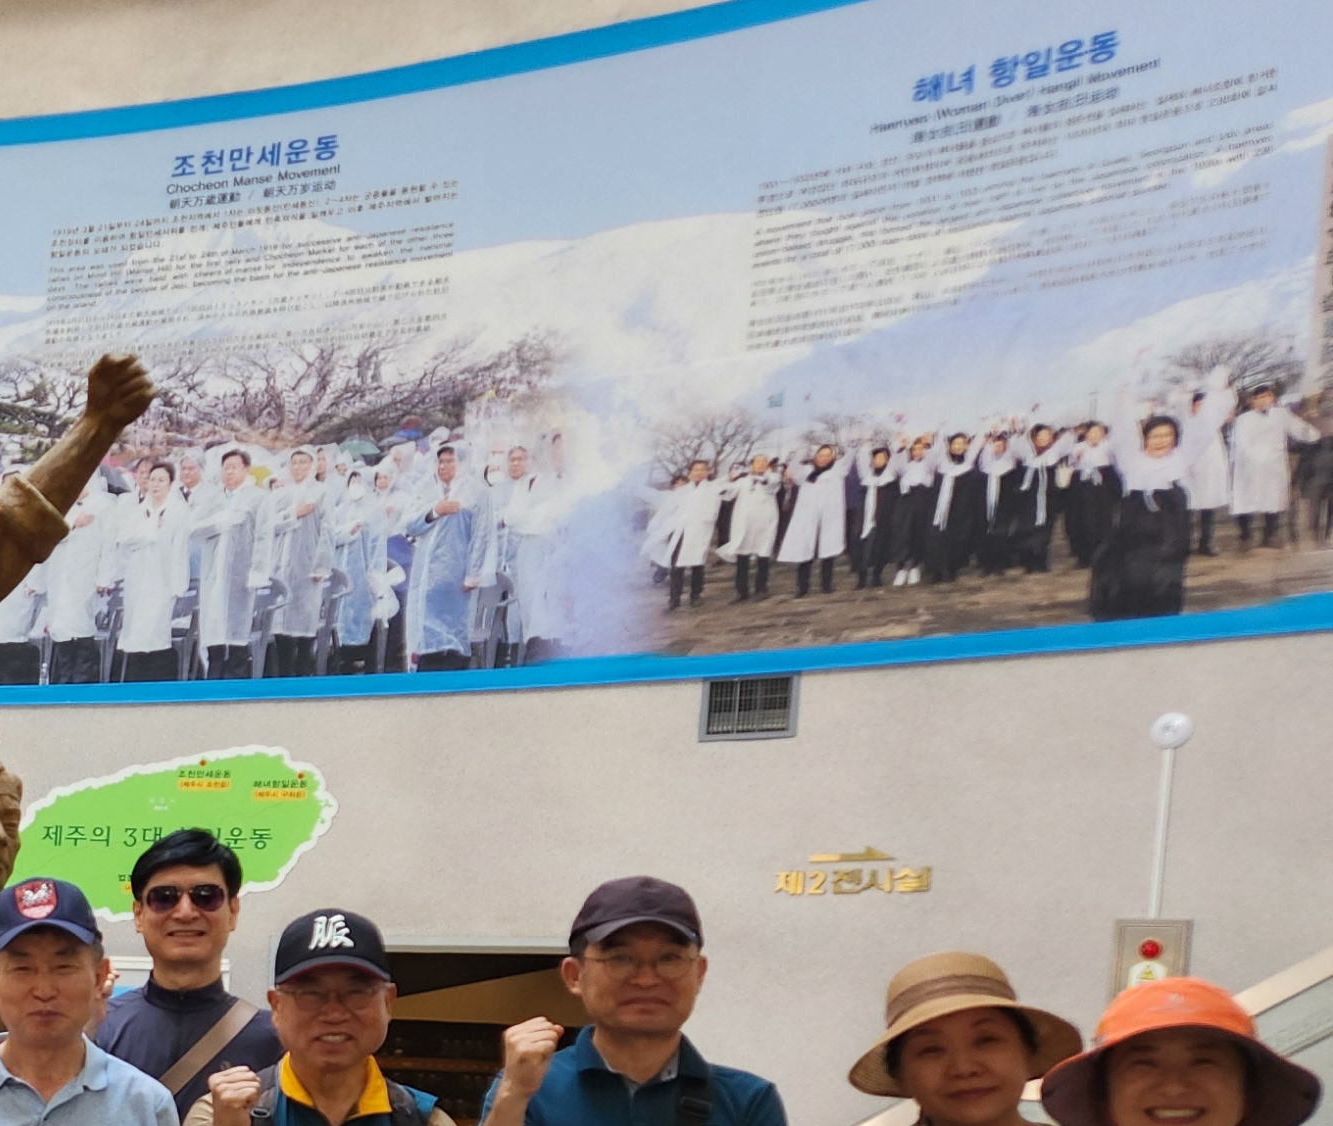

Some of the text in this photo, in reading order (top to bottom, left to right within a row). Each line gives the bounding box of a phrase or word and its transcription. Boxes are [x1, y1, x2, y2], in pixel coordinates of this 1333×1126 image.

[911, 30, 1120, 102] 해녀 항일운동
[171, 134, 339, 178] 조천만세운동
[166, 164, 341, 194] Chocheon Manse Movement
[41, 825, 111, 848] 제주의
[123, 825, 163, 848] 3대
[774, 866, 931, 895] 제2전시실
